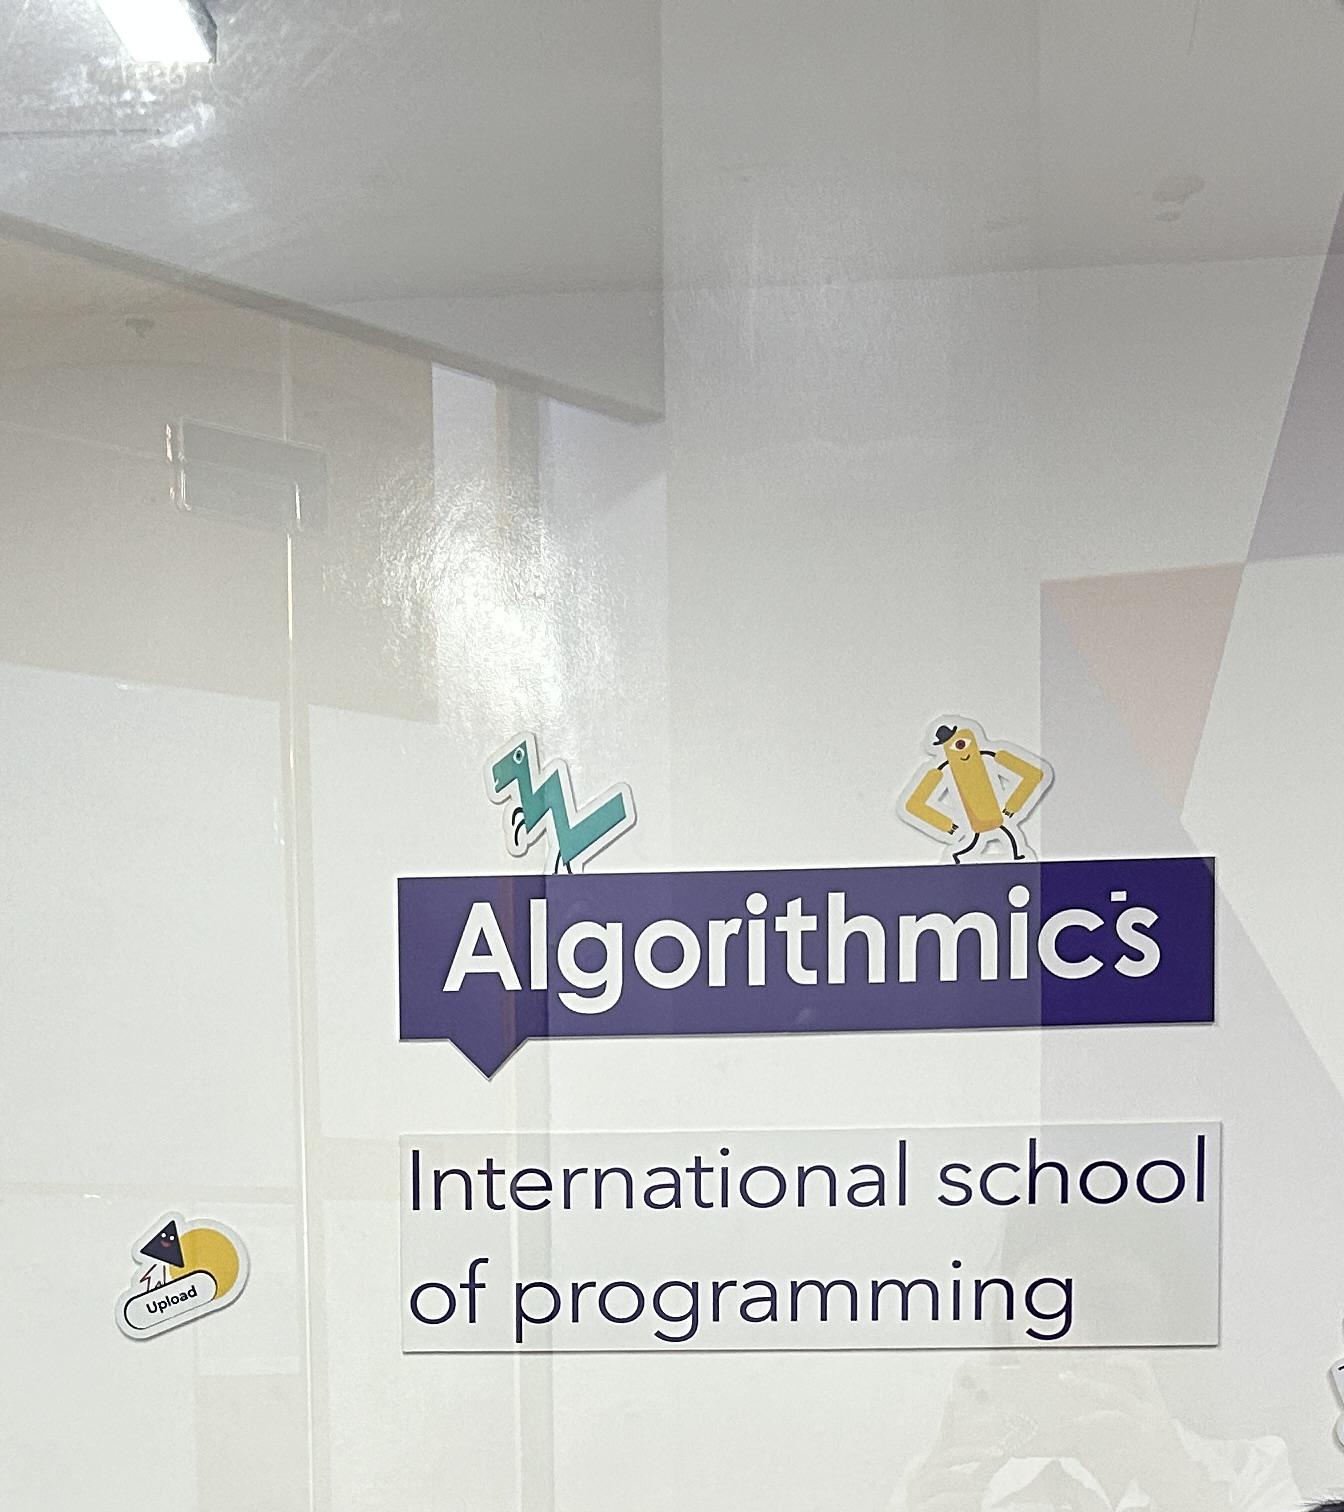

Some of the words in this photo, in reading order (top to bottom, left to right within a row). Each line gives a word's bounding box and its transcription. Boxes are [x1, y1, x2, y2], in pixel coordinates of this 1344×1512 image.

[442, 883, 1161, 1016] Algorithmics
[410, 1139, 910, 1213] International
[938, 1134, 1207, 1206] school
[146, 1285, 197, 1314] Upload
[410, 1257, 489, 1325] of
[514, 1261, 1075, 1343] programming
